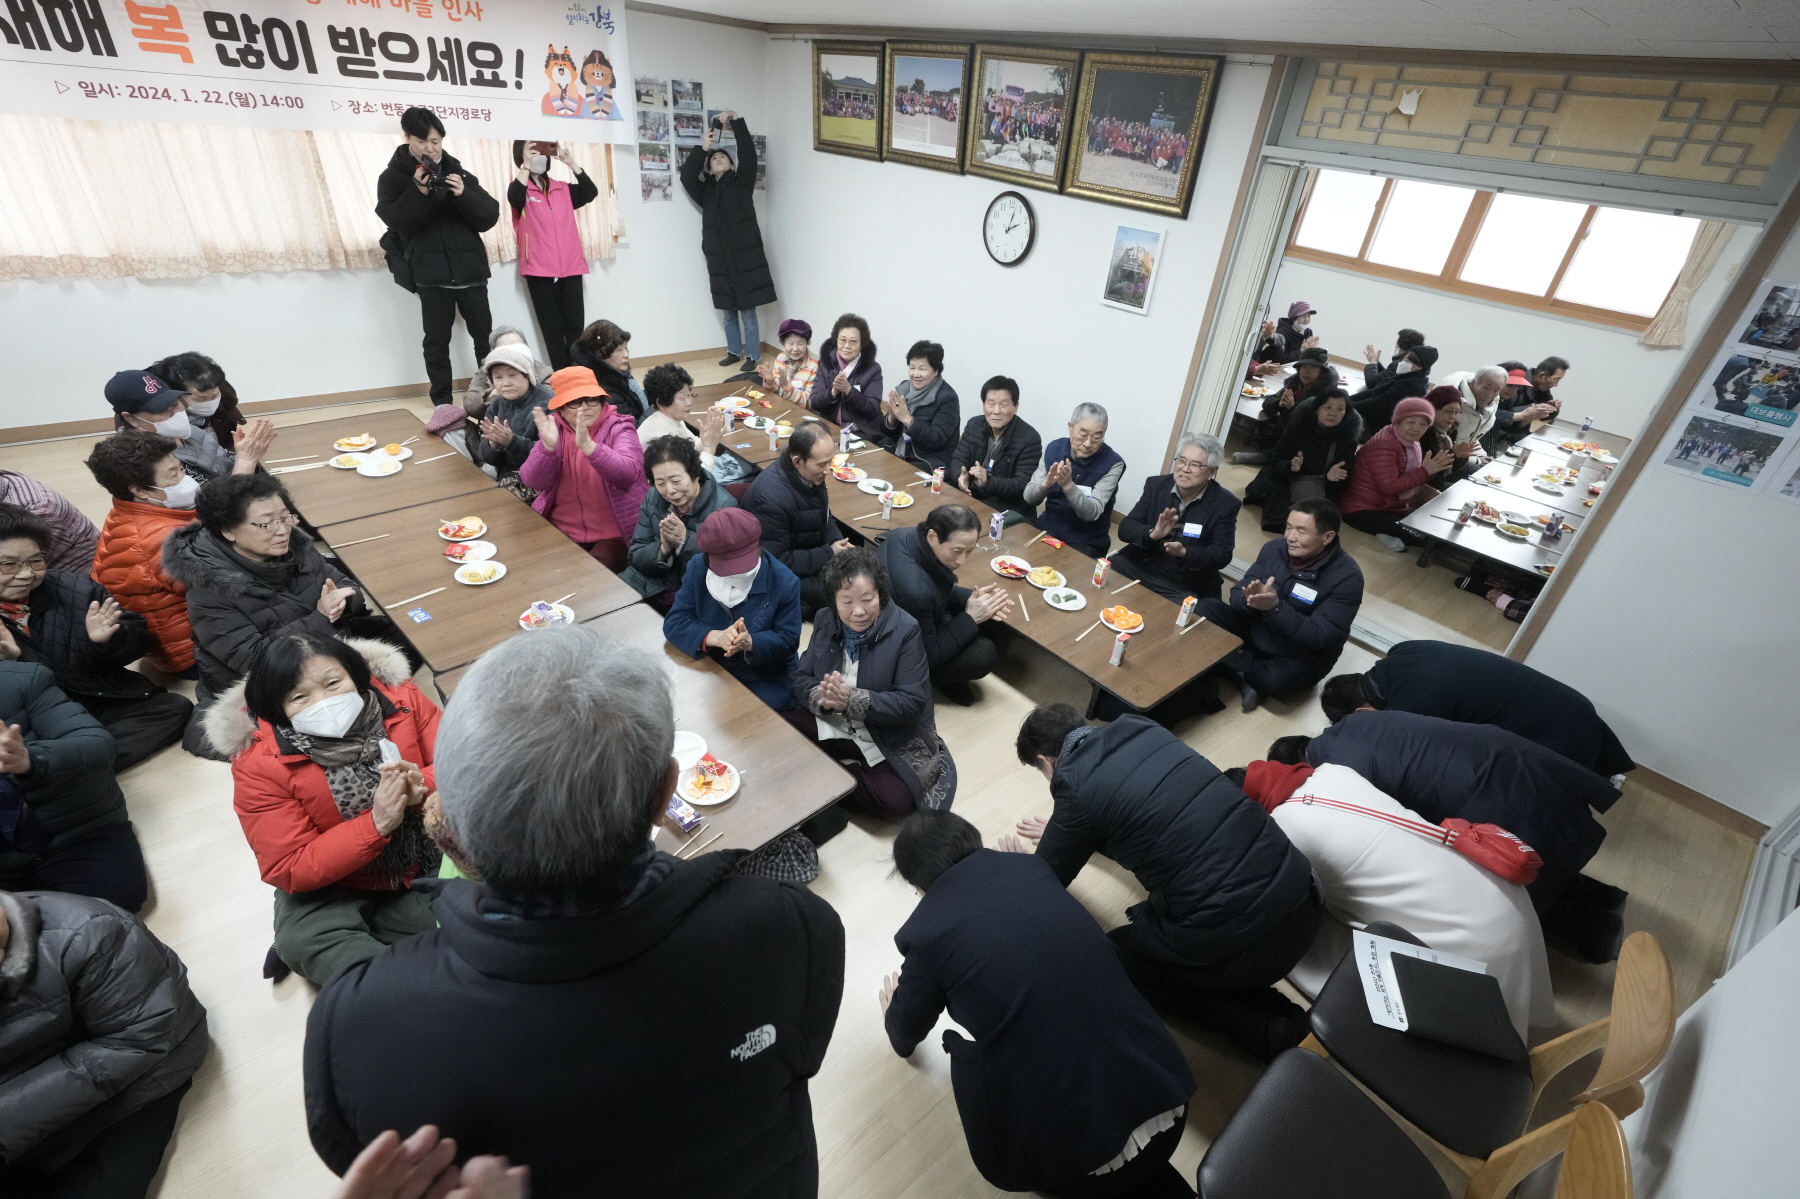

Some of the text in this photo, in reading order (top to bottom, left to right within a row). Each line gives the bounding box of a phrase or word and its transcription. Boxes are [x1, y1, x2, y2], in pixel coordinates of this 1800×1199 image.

[441, 0, 484, 22] 인사
[589, 5, 615, 35] 강북
[124, 0, 195, 65] 복
[203, 11, 318, 75] 많이
[327, 25, 525, 91] 받으세요!
[77, 81, 121, 99] 일시:
[125, 84, 177, 102] 2024.
[180, 88, 198, 103] 1.
[348, 100, 379, 115] 장소:
[745, 1026, 763, 1042] THE
[731, 1035, 763, 1058] NORTH
[740, 1042, 763, 1062] FACE
